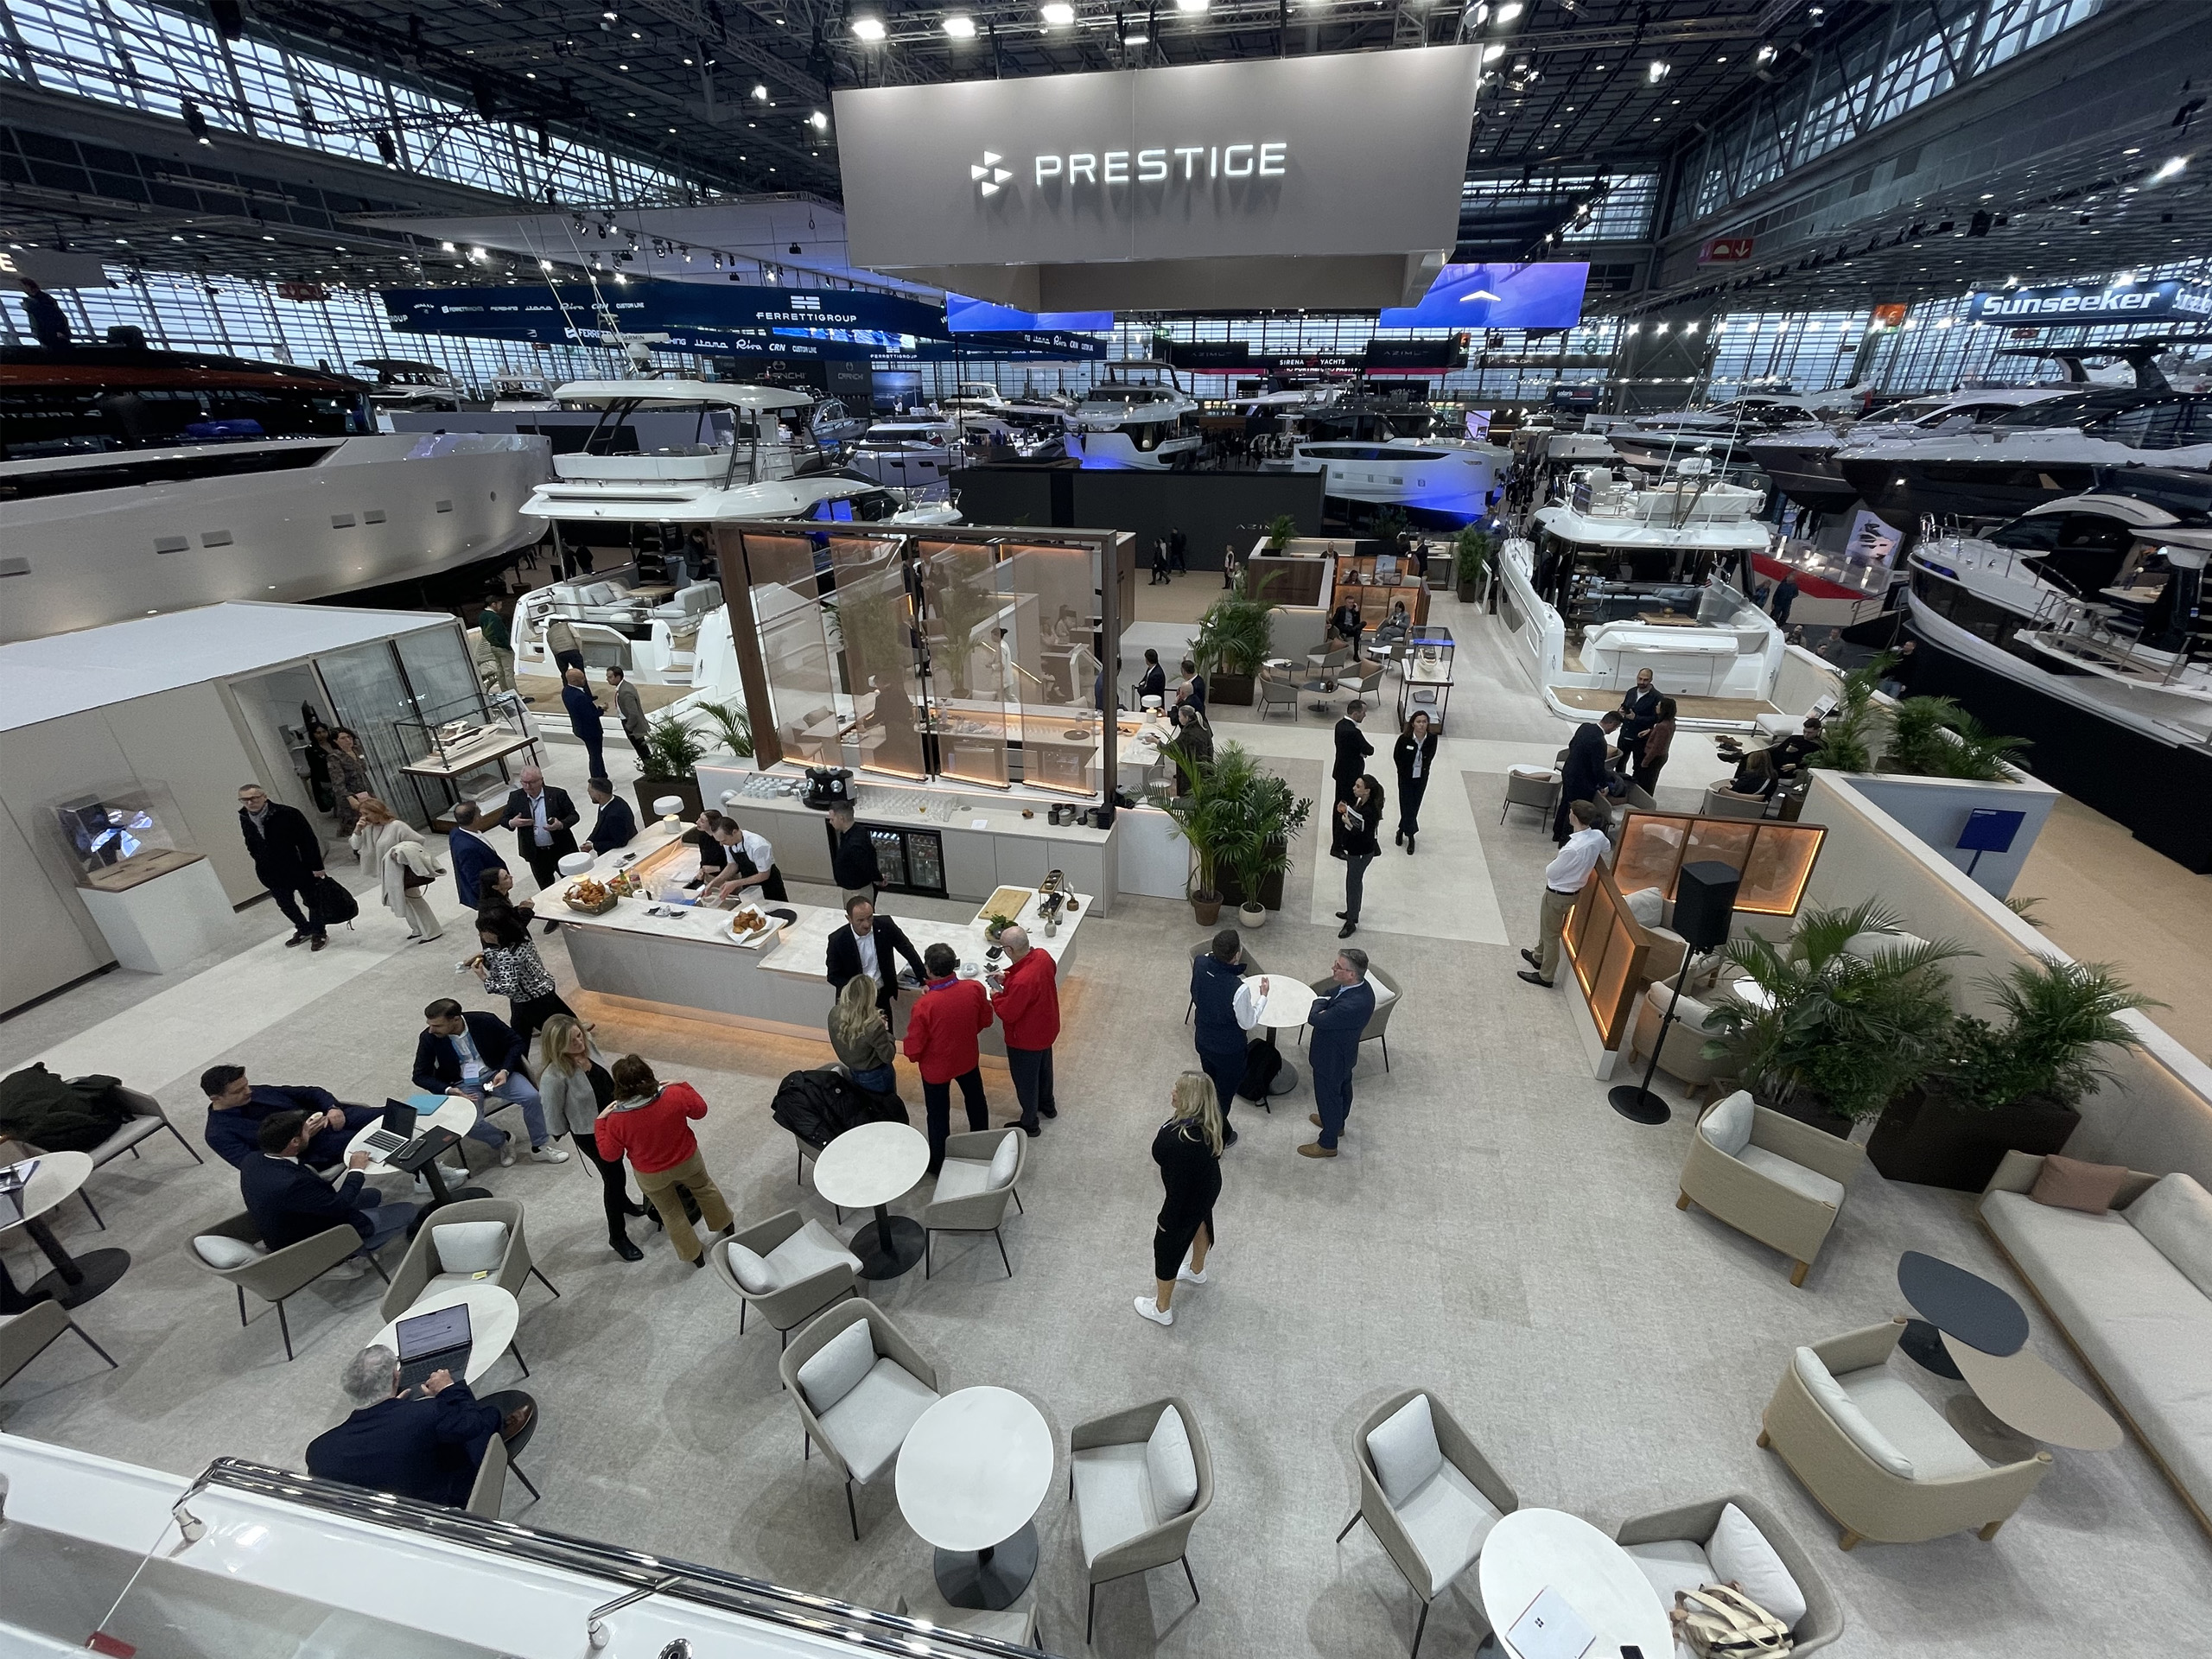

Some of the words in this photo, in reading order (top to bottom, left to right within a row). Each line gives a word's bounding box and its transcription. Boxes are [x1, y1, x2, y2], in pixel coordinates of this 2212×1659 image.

[1036, 143, 1287, 185] PRESTIGE
[1981, 290, 2160, 316] Sunseeker
[756, 312, 857, 322] FERRETTIGROUP
[736, 339, 762, 351] Riva
[768, 343, 785, 352] CRN
